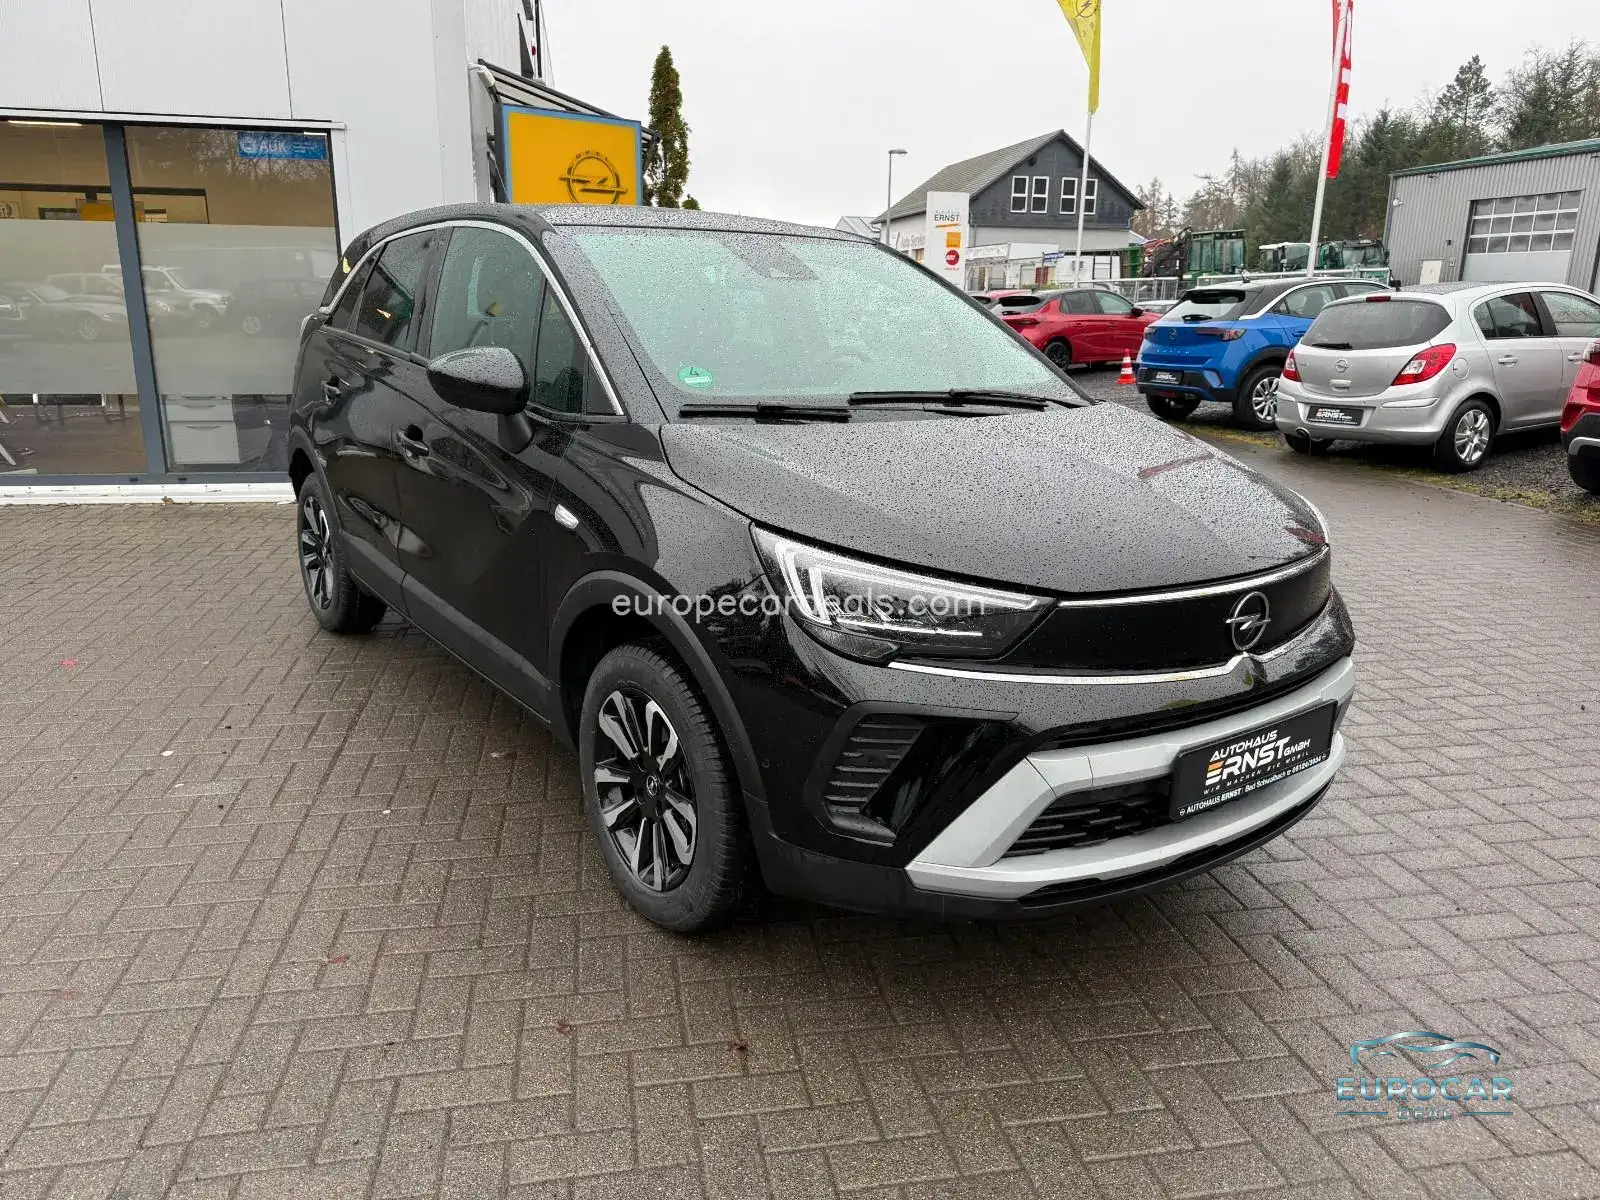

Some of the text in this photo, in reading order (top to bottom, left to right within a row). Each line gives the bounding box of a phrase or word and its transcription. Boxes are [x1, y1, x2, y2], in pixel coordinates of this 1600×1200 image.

[934, 214, 960, 222] ERNST
[690, 366, 700, 377] 4
[1209, 729, 1278, 763] AUTOHAUS
[1205, 736, 1292, 786] ERNST
[1203, 785, 1220, 795] WIR
[1226, 769, 1261, 787] MACHEN
[1186, 795, 1221, 814] AUTOHAUS
[1220, 787, 1242, 802] ERNST
[1244, 782, 1257, 793] Bad
